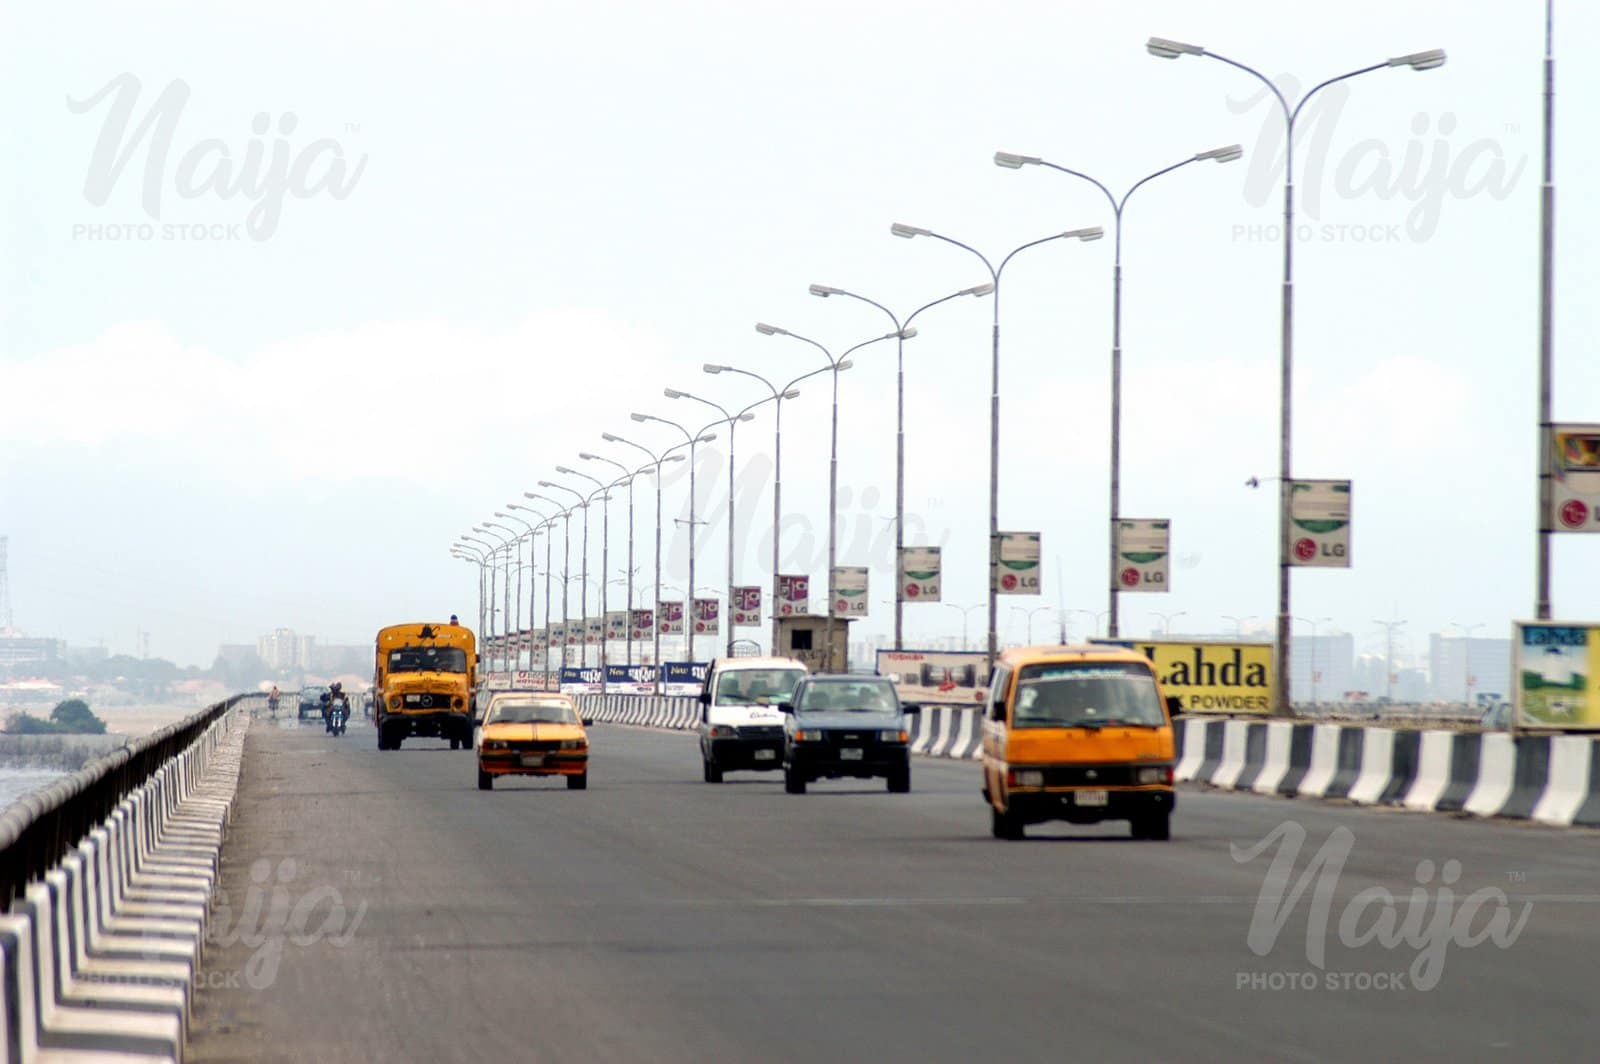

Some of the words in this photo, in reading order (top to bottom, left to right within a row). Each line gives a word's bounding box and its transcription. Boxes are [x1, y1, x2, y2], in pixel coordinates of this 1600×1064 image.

[1321, 543, 1345, 557] LG
[1020, 577, 1038, 588] LG
[1143, 571, 1165, 584] LG
[922, 586, 938, 595] LG
[795, 606, 808, 614] LG
[850, 602, 865, 610] LG
[1190, 695, 1270, 709] POWDER
